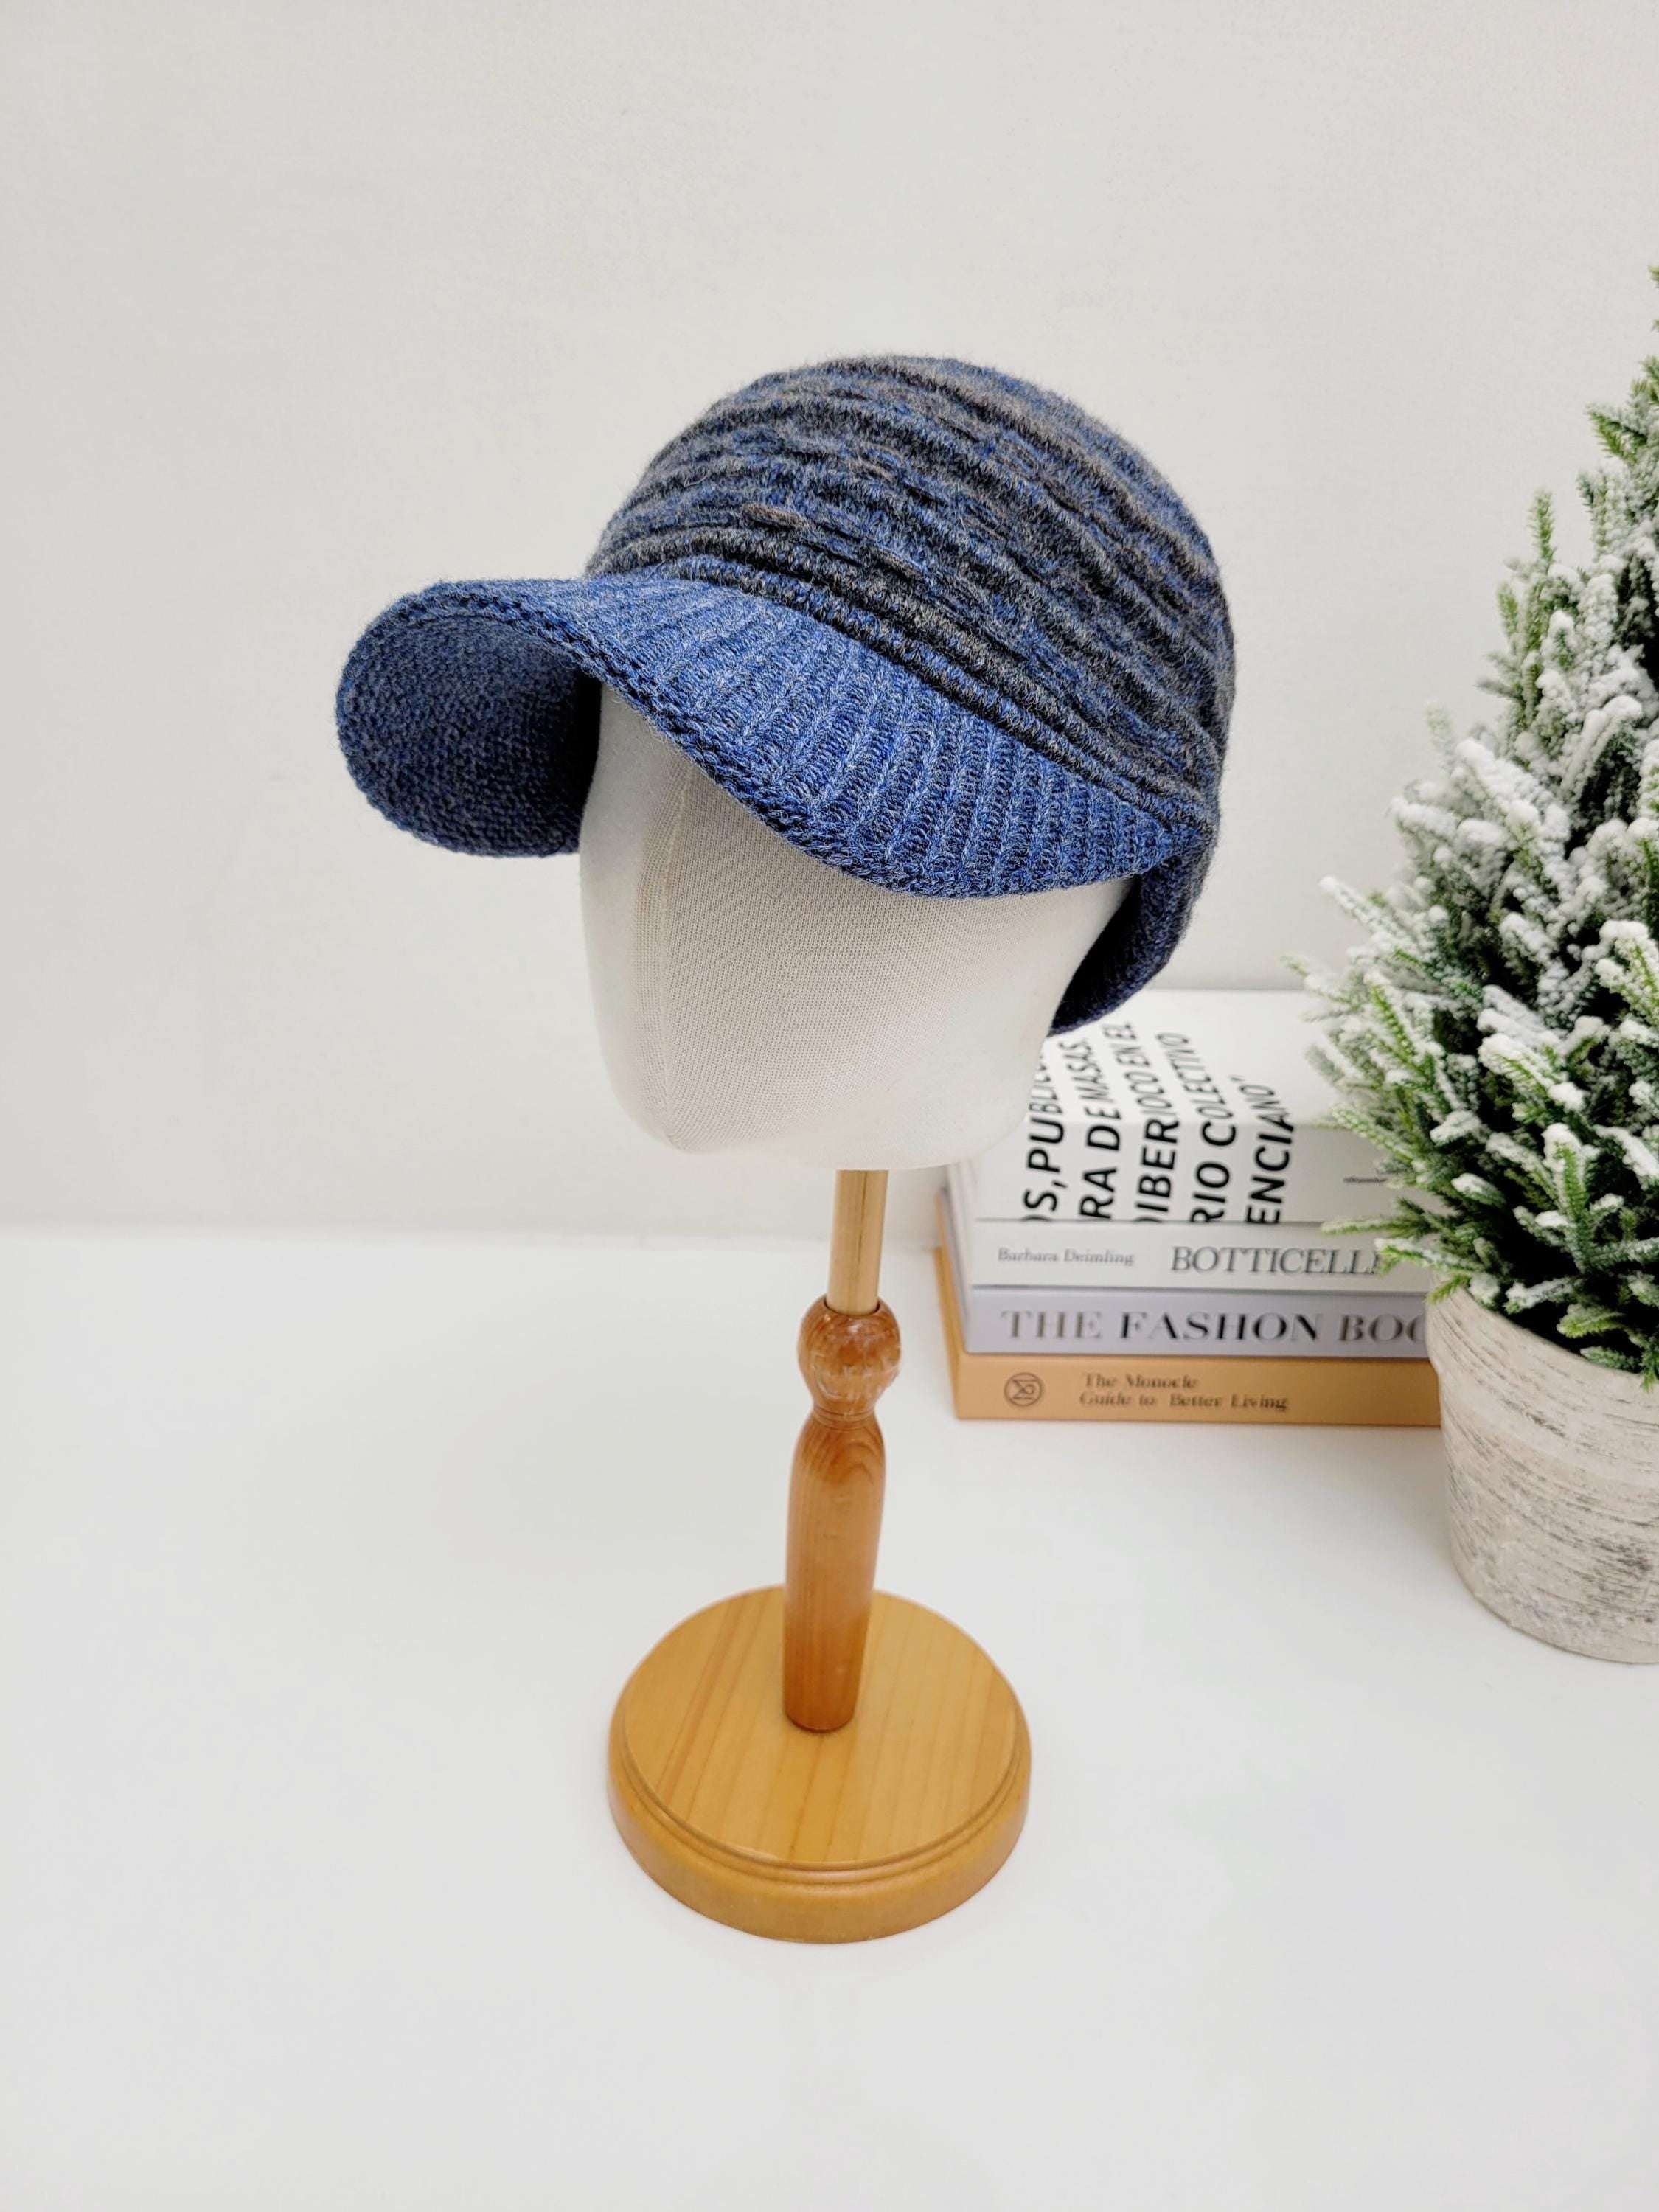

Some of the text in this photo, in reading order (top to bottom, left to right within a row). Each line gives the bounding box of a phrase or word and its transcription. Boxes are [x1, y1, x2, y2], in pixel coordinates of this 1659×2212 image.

[1112, 1044, 1151, 1066] EN
[1156, 1032, 1237, 1147] COLECTIVO
[1085, 1105, 1122, 1152] DE
[1124, 1071, 1180, 1222] IBERIOCO
[998, 1247, 1058, 1262] Barbara
[1001, 1310, 1102, 1340] THE
[1085, 1372, 1199, 1389] The Monocle
[1079, 1392, 1289, 1412] Guide to Better Living
